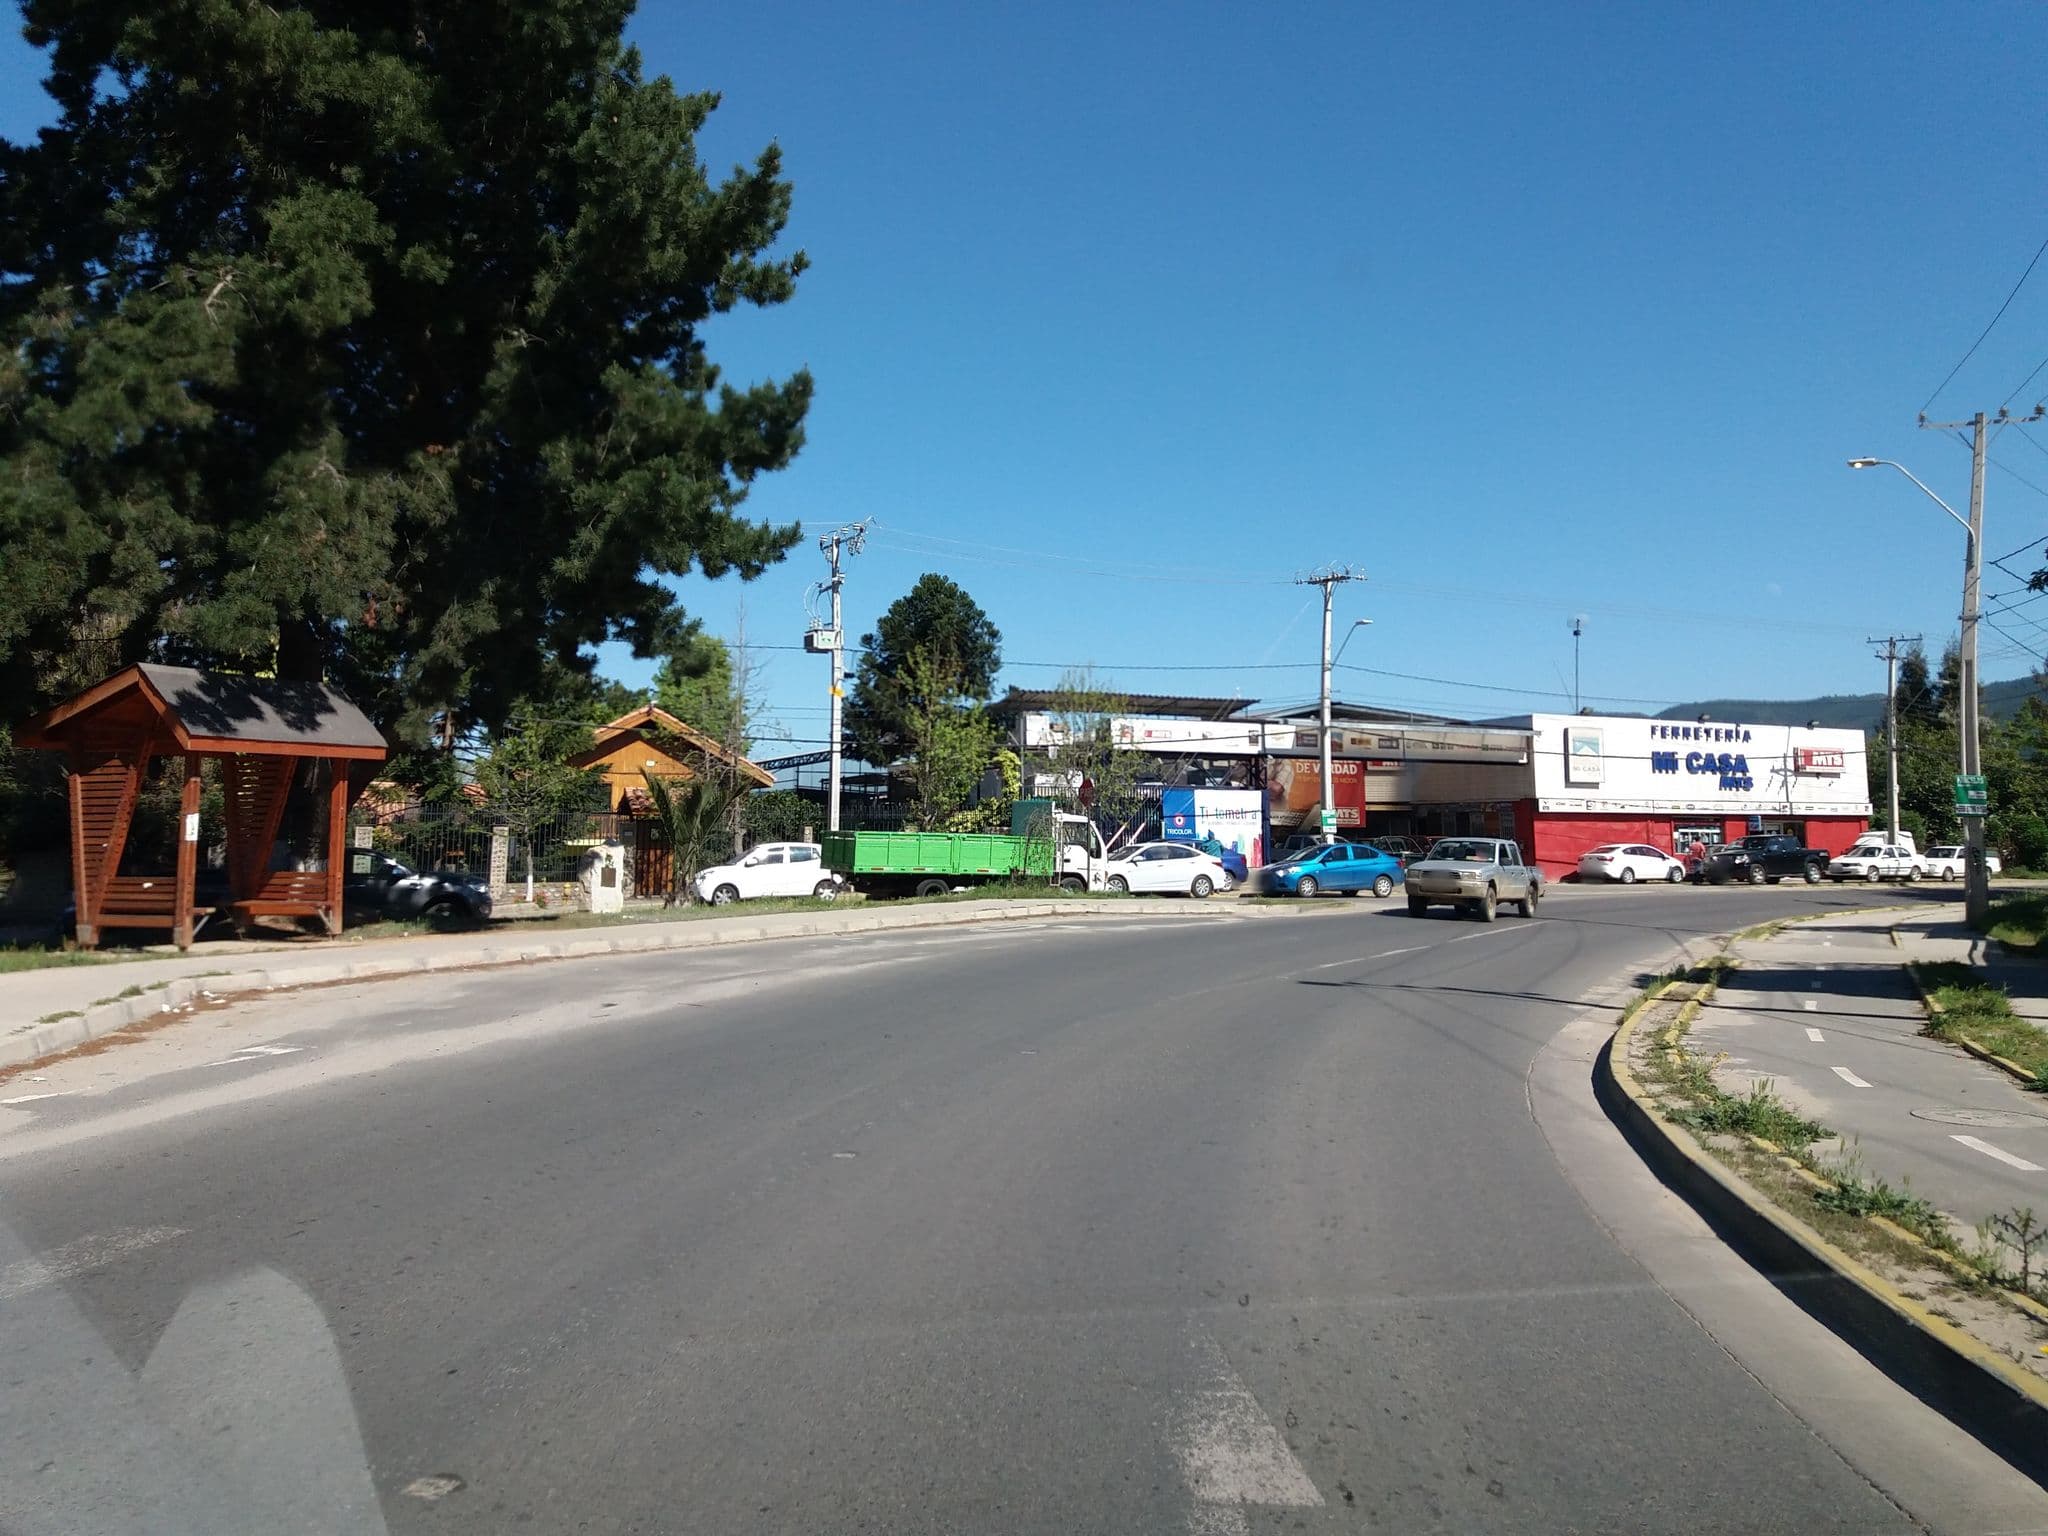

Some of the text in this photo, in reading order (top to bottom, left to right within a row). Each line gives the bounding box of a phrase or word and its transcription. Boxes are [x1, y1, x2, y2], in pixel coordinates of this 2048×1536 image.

[1685, 751, 1750, 777] CASA
[1812, 751, 1843, 766] MTS
[1296, 762, 1358, 775] DE VRDAD
[1719, 776, 1754, 792] MTS
